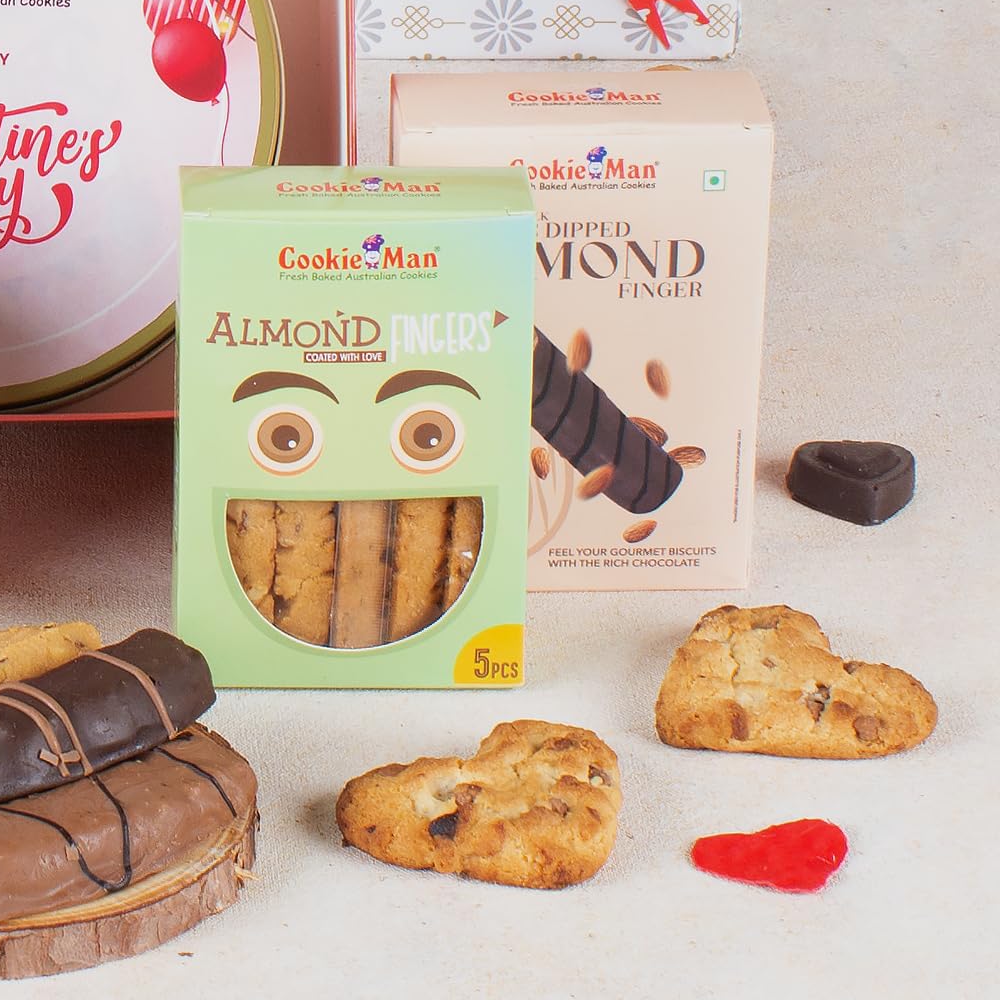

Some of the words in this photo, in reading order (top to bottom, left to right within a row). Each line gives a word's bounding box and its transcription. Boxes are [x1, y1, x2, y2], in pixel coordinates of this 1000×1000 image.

[508, 92, 587, 101] Cookie
[276, 181, 362, 193] Cookie
[546, 221, 631, 238] DIPPED
[278, 246, 363, 270] Cookie
[536, 239, 705, 280] MOND
[279, 272, 308, 281] Fresh
[312, 273, 342, 281] Baked
[346, 273, 397, 281] Australian
[400, 271, 438, 280] Cookies
[619, 281, 702, 298] FINGER
[206, 312, 381, 348] ALMOND
[390, 311, 492, 363] FINGERS
[306, 353, 337, 362] COATED
[340, 353, 360, 361] WITH
[362, 352, 382, 361] LOVE
[549, 548, 574, 556] FEEL
[576, 548, 607, 556] YOUR
[610, 548, 666, 556] GOURMET
[669, 547, 716, 556] BISCUITS
[549, 559, 576, 567] WITH
[579, 559, 600, 567] THE
[603, 559, 629, 567] RICH
[632, 558, 700, 567] CHOCOLATE
